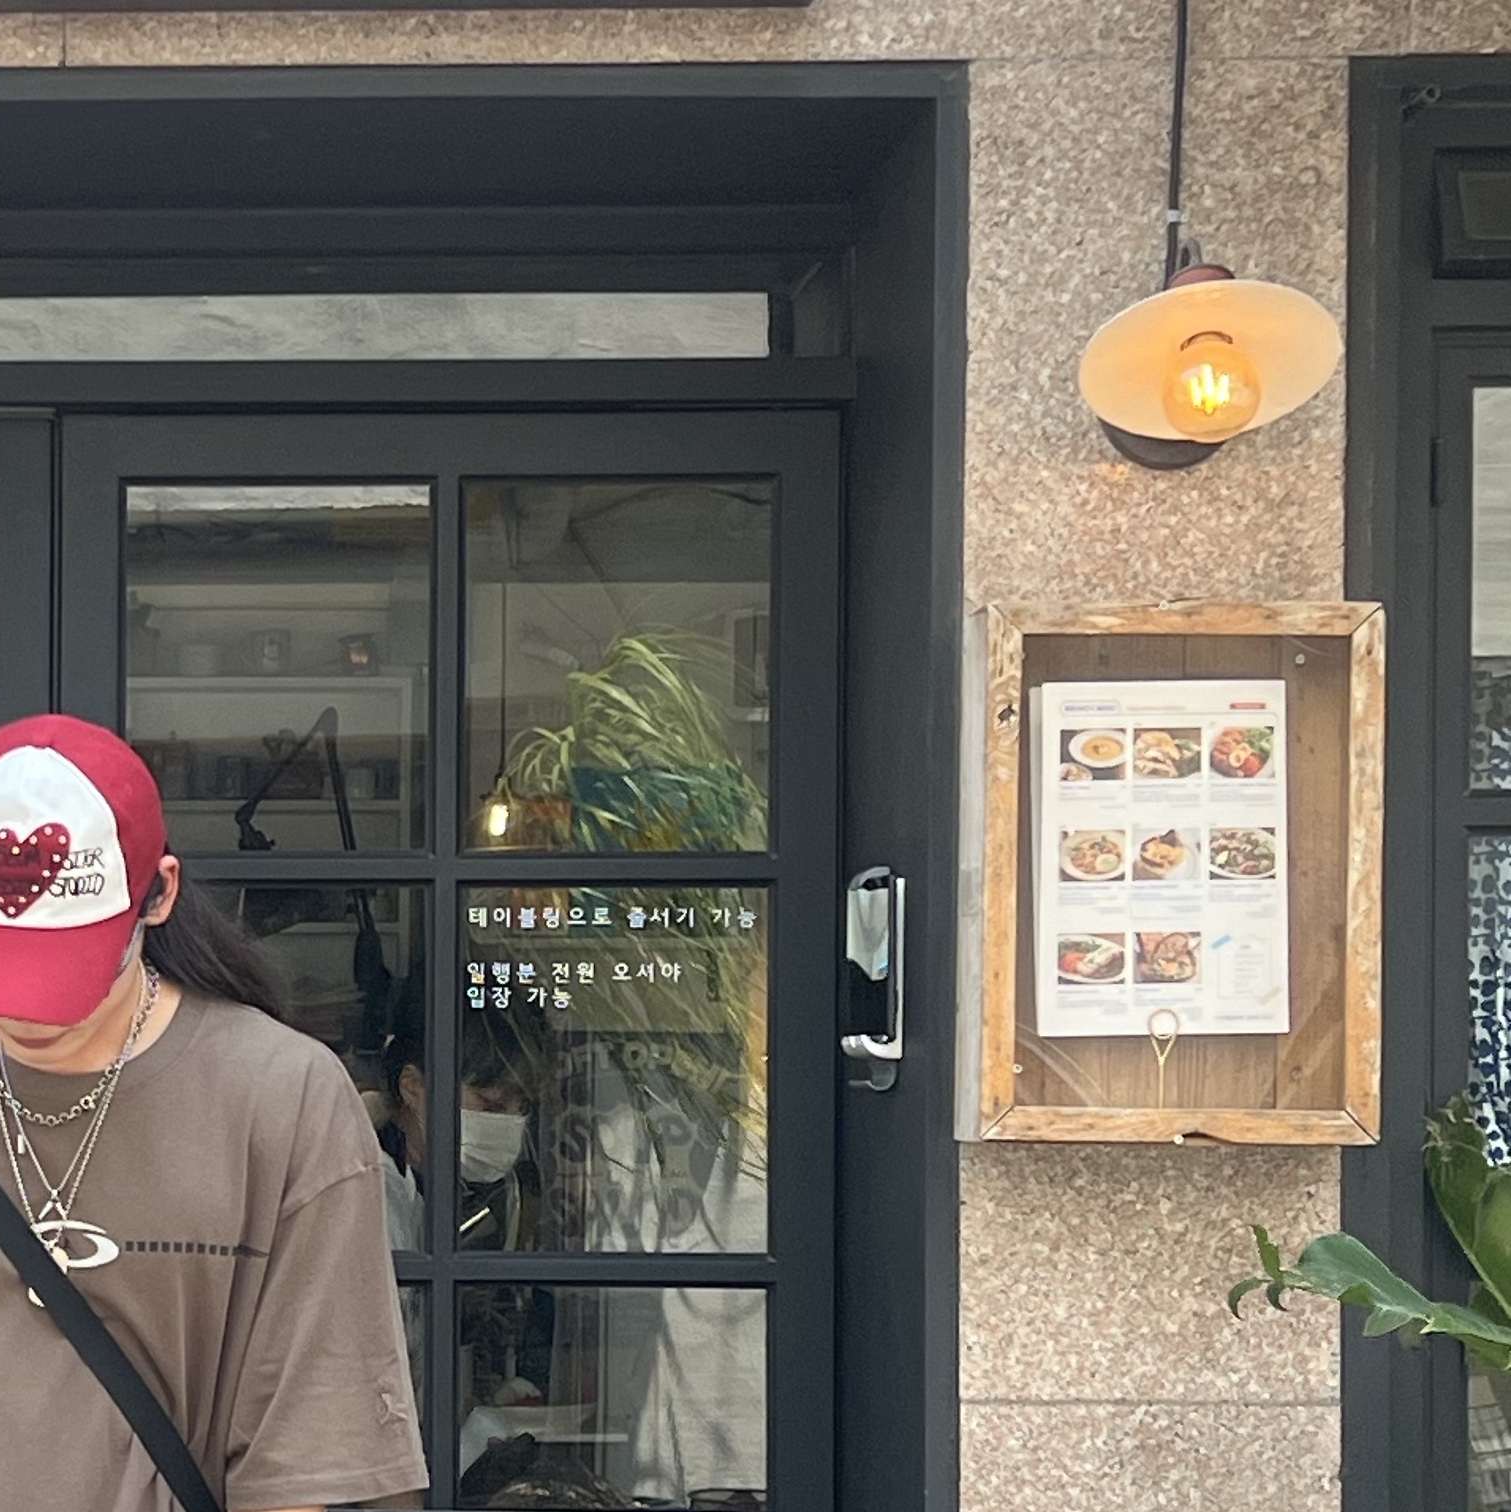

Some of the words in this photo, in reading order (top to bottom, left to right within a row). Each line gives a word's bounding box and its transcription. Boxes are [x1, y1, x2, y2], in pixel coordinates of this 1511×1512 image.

[467, 907, 613, 929] 테이블링으로
[627, 906, 696, 929] 줄서기
[711, 907, 758, 929] 가능
[551, 962, 596, 984] 전원
[466, 986, 512, 1009] 입장
[526, 986, 573, 1009] 가능
